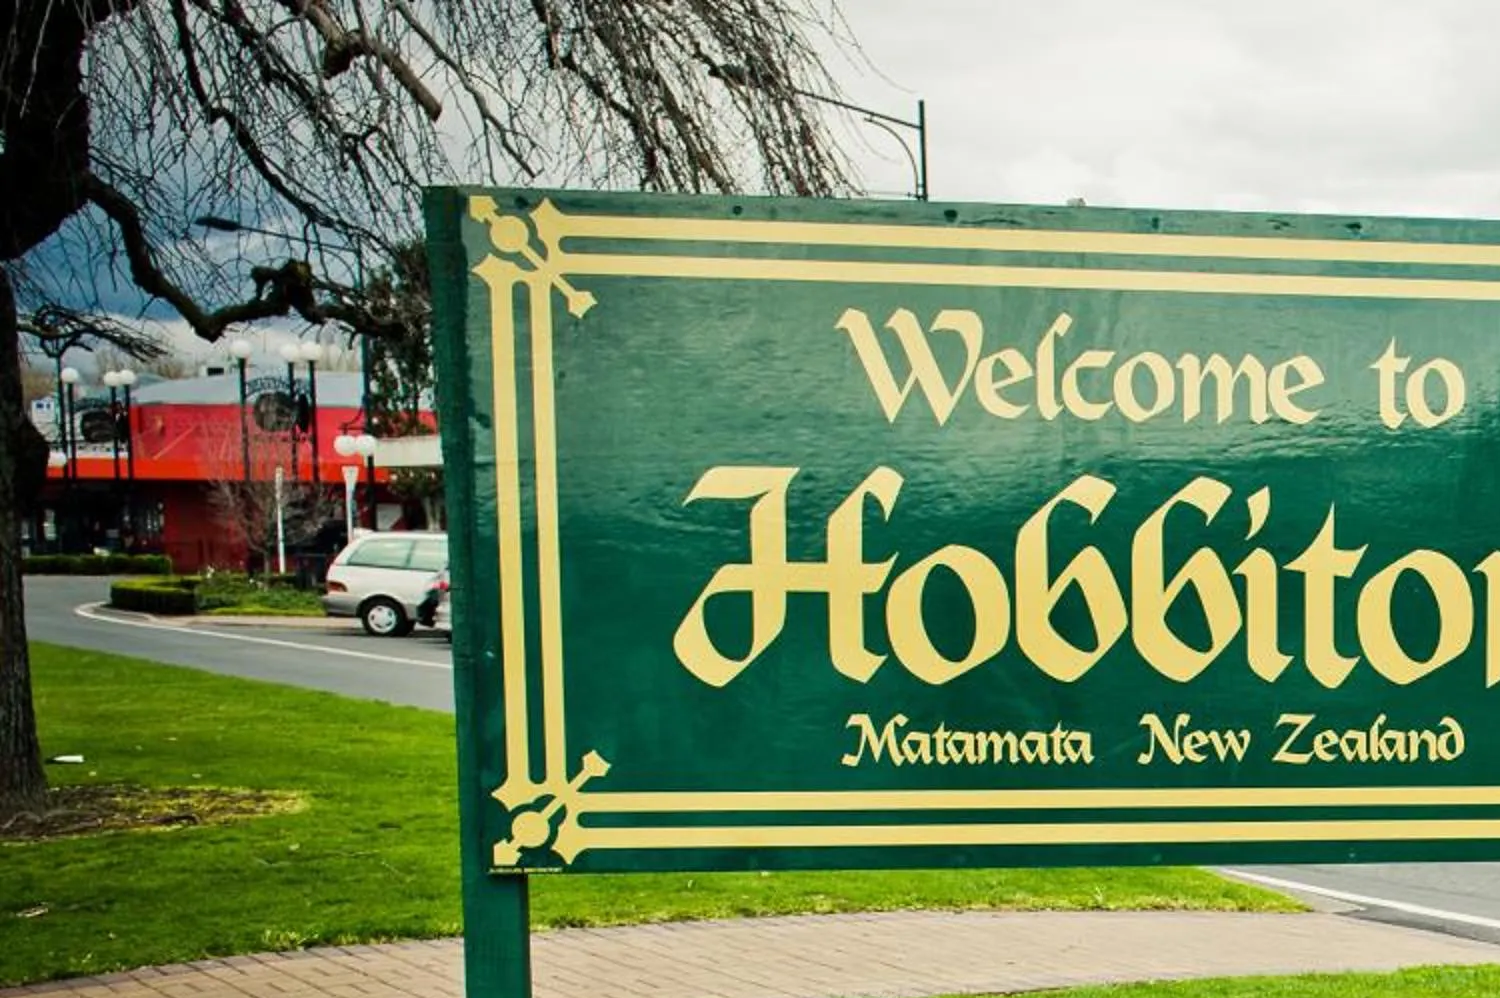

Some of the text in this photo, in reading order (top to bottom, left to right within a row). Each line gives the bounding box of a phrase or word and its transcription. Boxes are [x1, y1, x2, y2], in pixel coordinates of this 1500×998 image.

[836, 308, 1466, 429] Welcome to
[842, 713, 1466, 766] Matamata New Zealand
